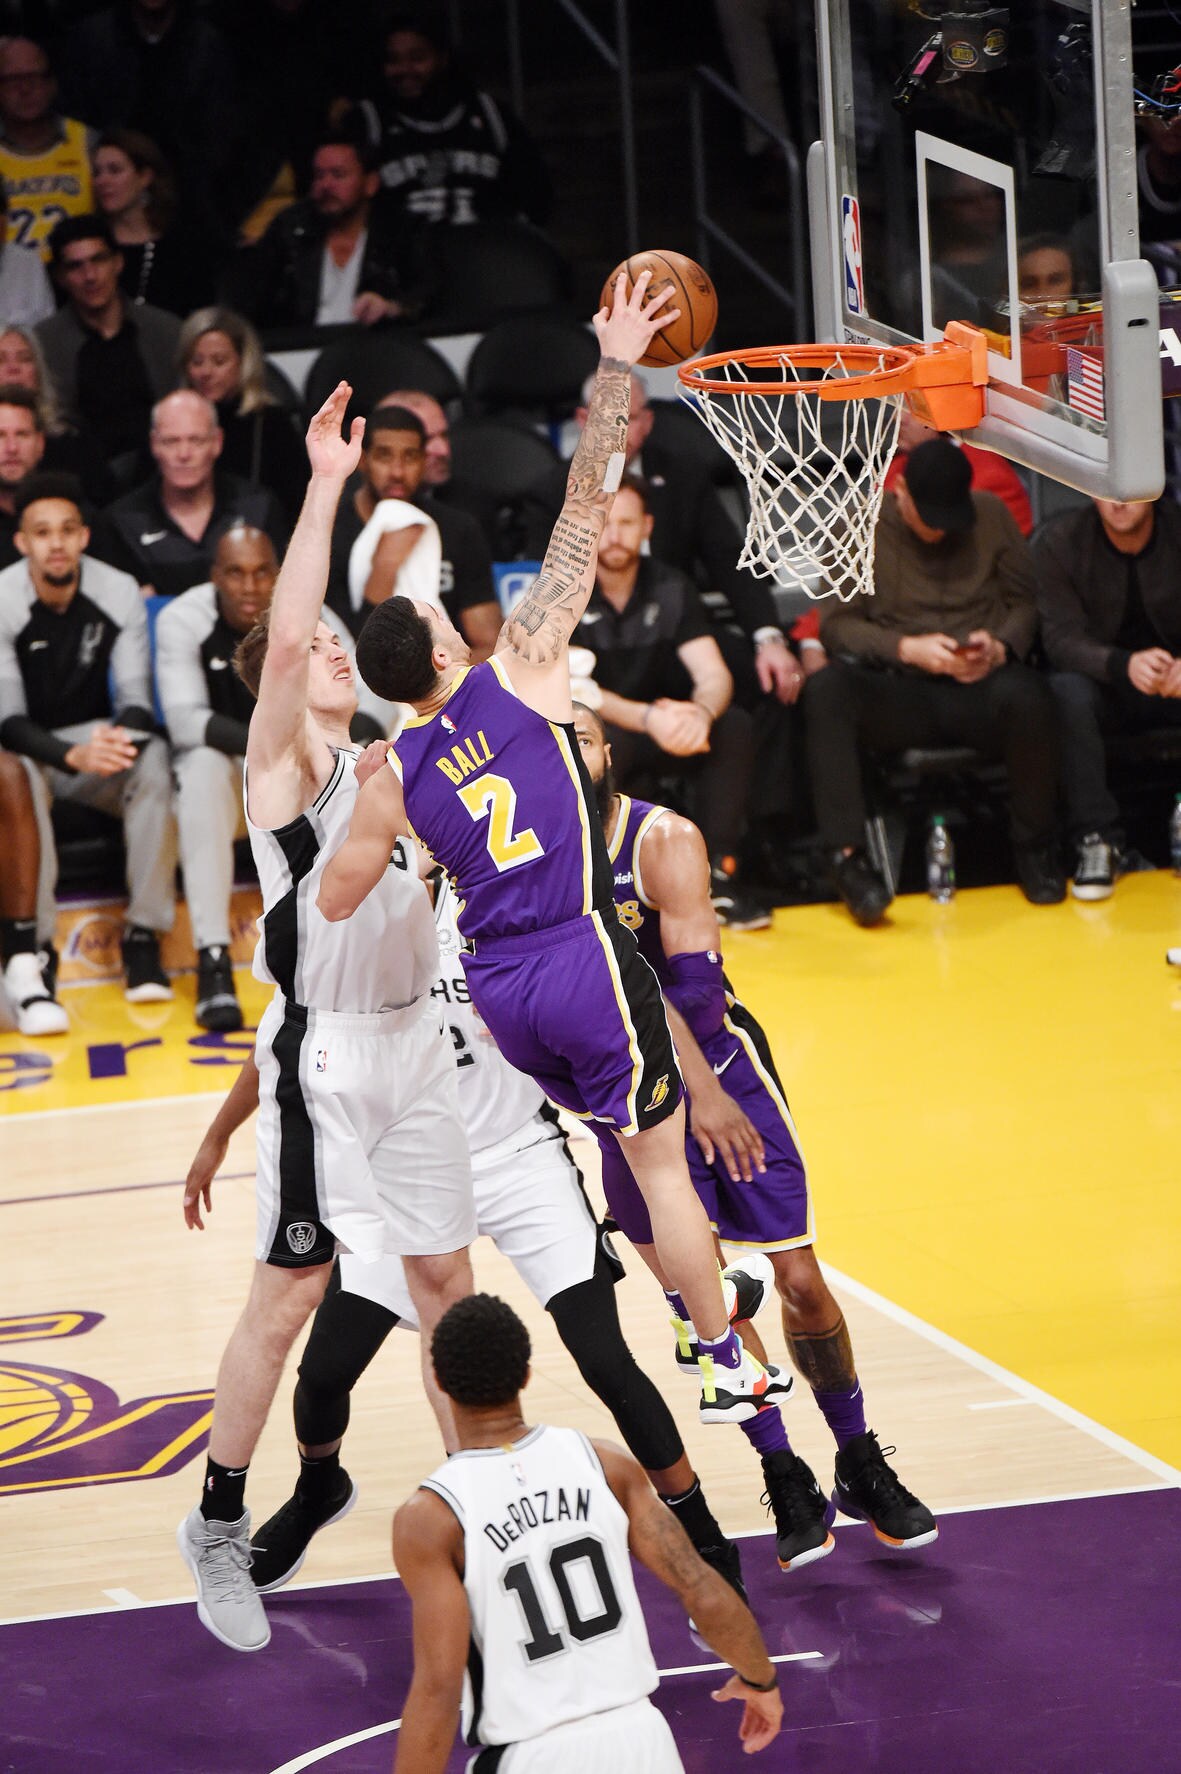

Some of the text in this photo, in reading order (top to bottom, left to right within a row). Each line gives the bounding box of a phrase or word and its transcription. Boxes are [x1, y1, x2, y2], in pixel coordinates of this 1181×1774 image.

[435, 730, 495, 786] BALL
[456, 772, 545, 873] 2
[502, 1536, 623, 1662] 10
